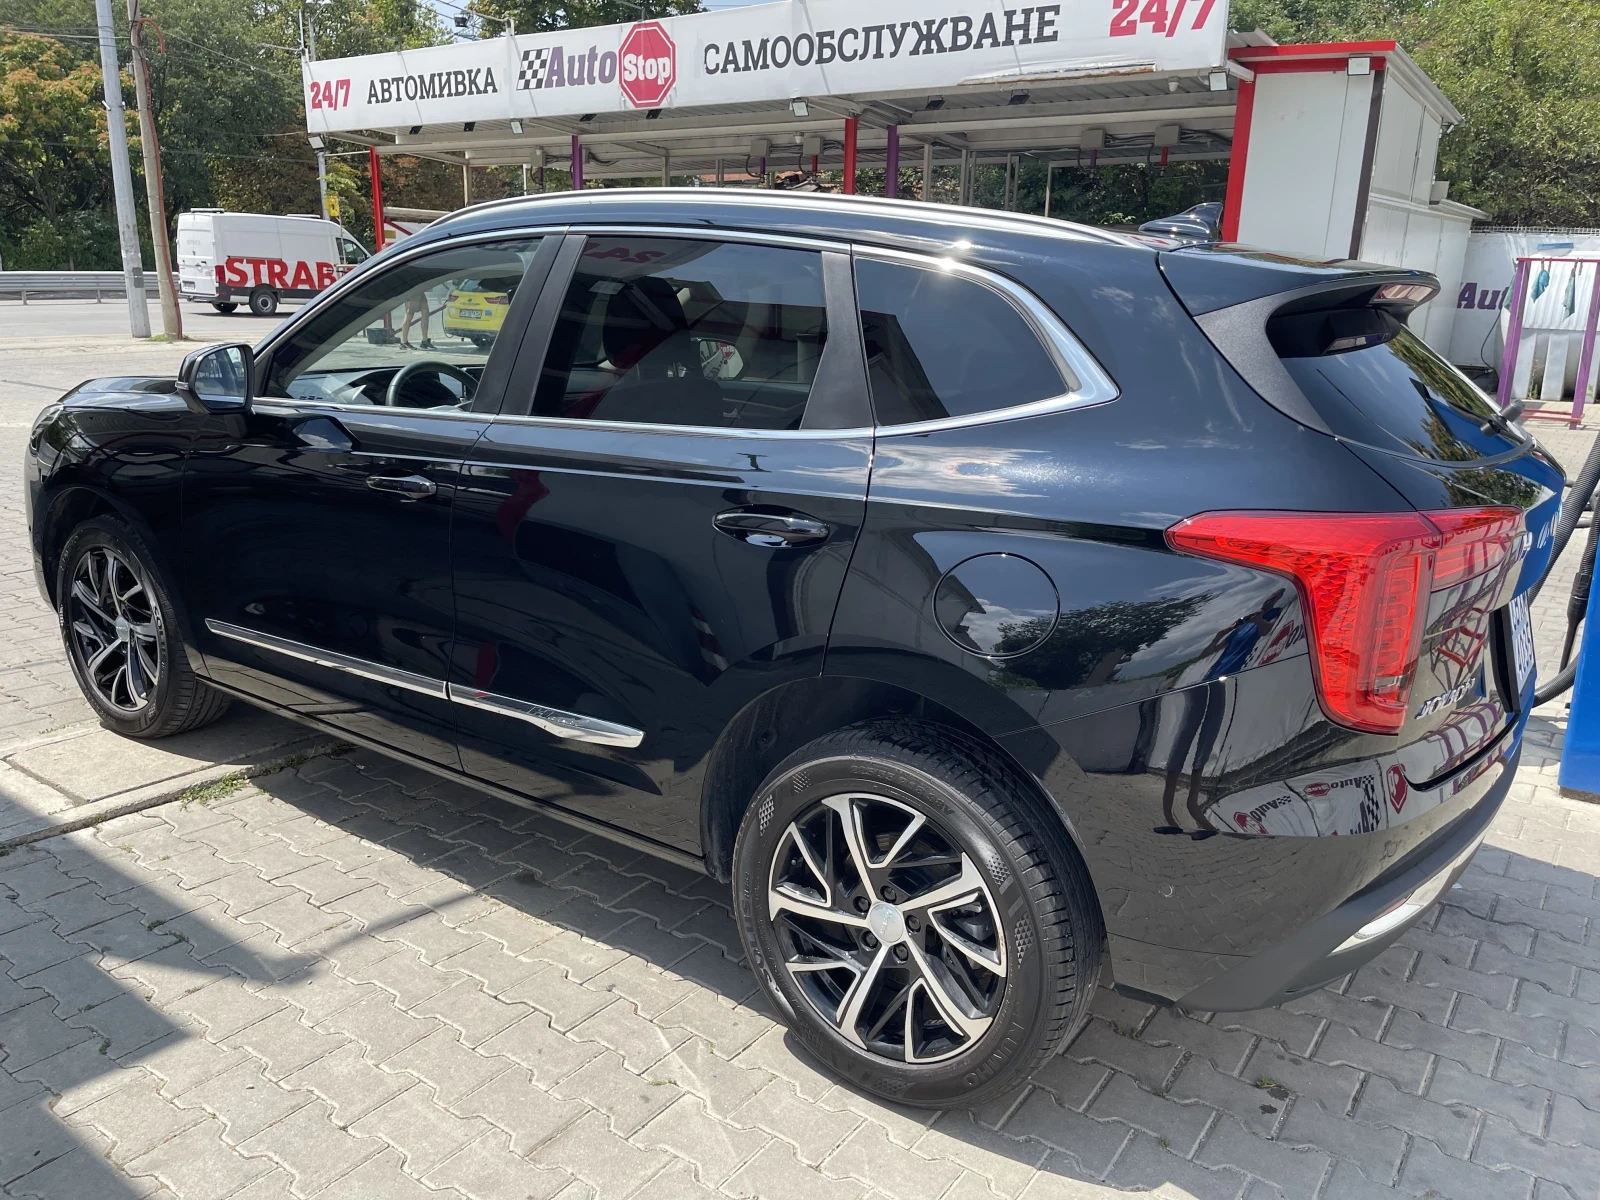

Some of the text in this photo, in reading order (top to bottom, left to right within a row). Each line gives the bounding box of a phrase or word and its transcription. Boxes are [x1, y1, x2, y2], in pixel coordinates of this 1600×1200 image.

[1109, 0, 1216, 38] 24/7
[703, 3, 1062, 76] САМООБСЛУЖВАНЕ
[366, 66, 498, 105] АВТОМИВКА
[544, 45, 671, 88] Auto Stop
[310, 79, 351, 110] 24/7
[226, 256, 344, 290] STRAB
